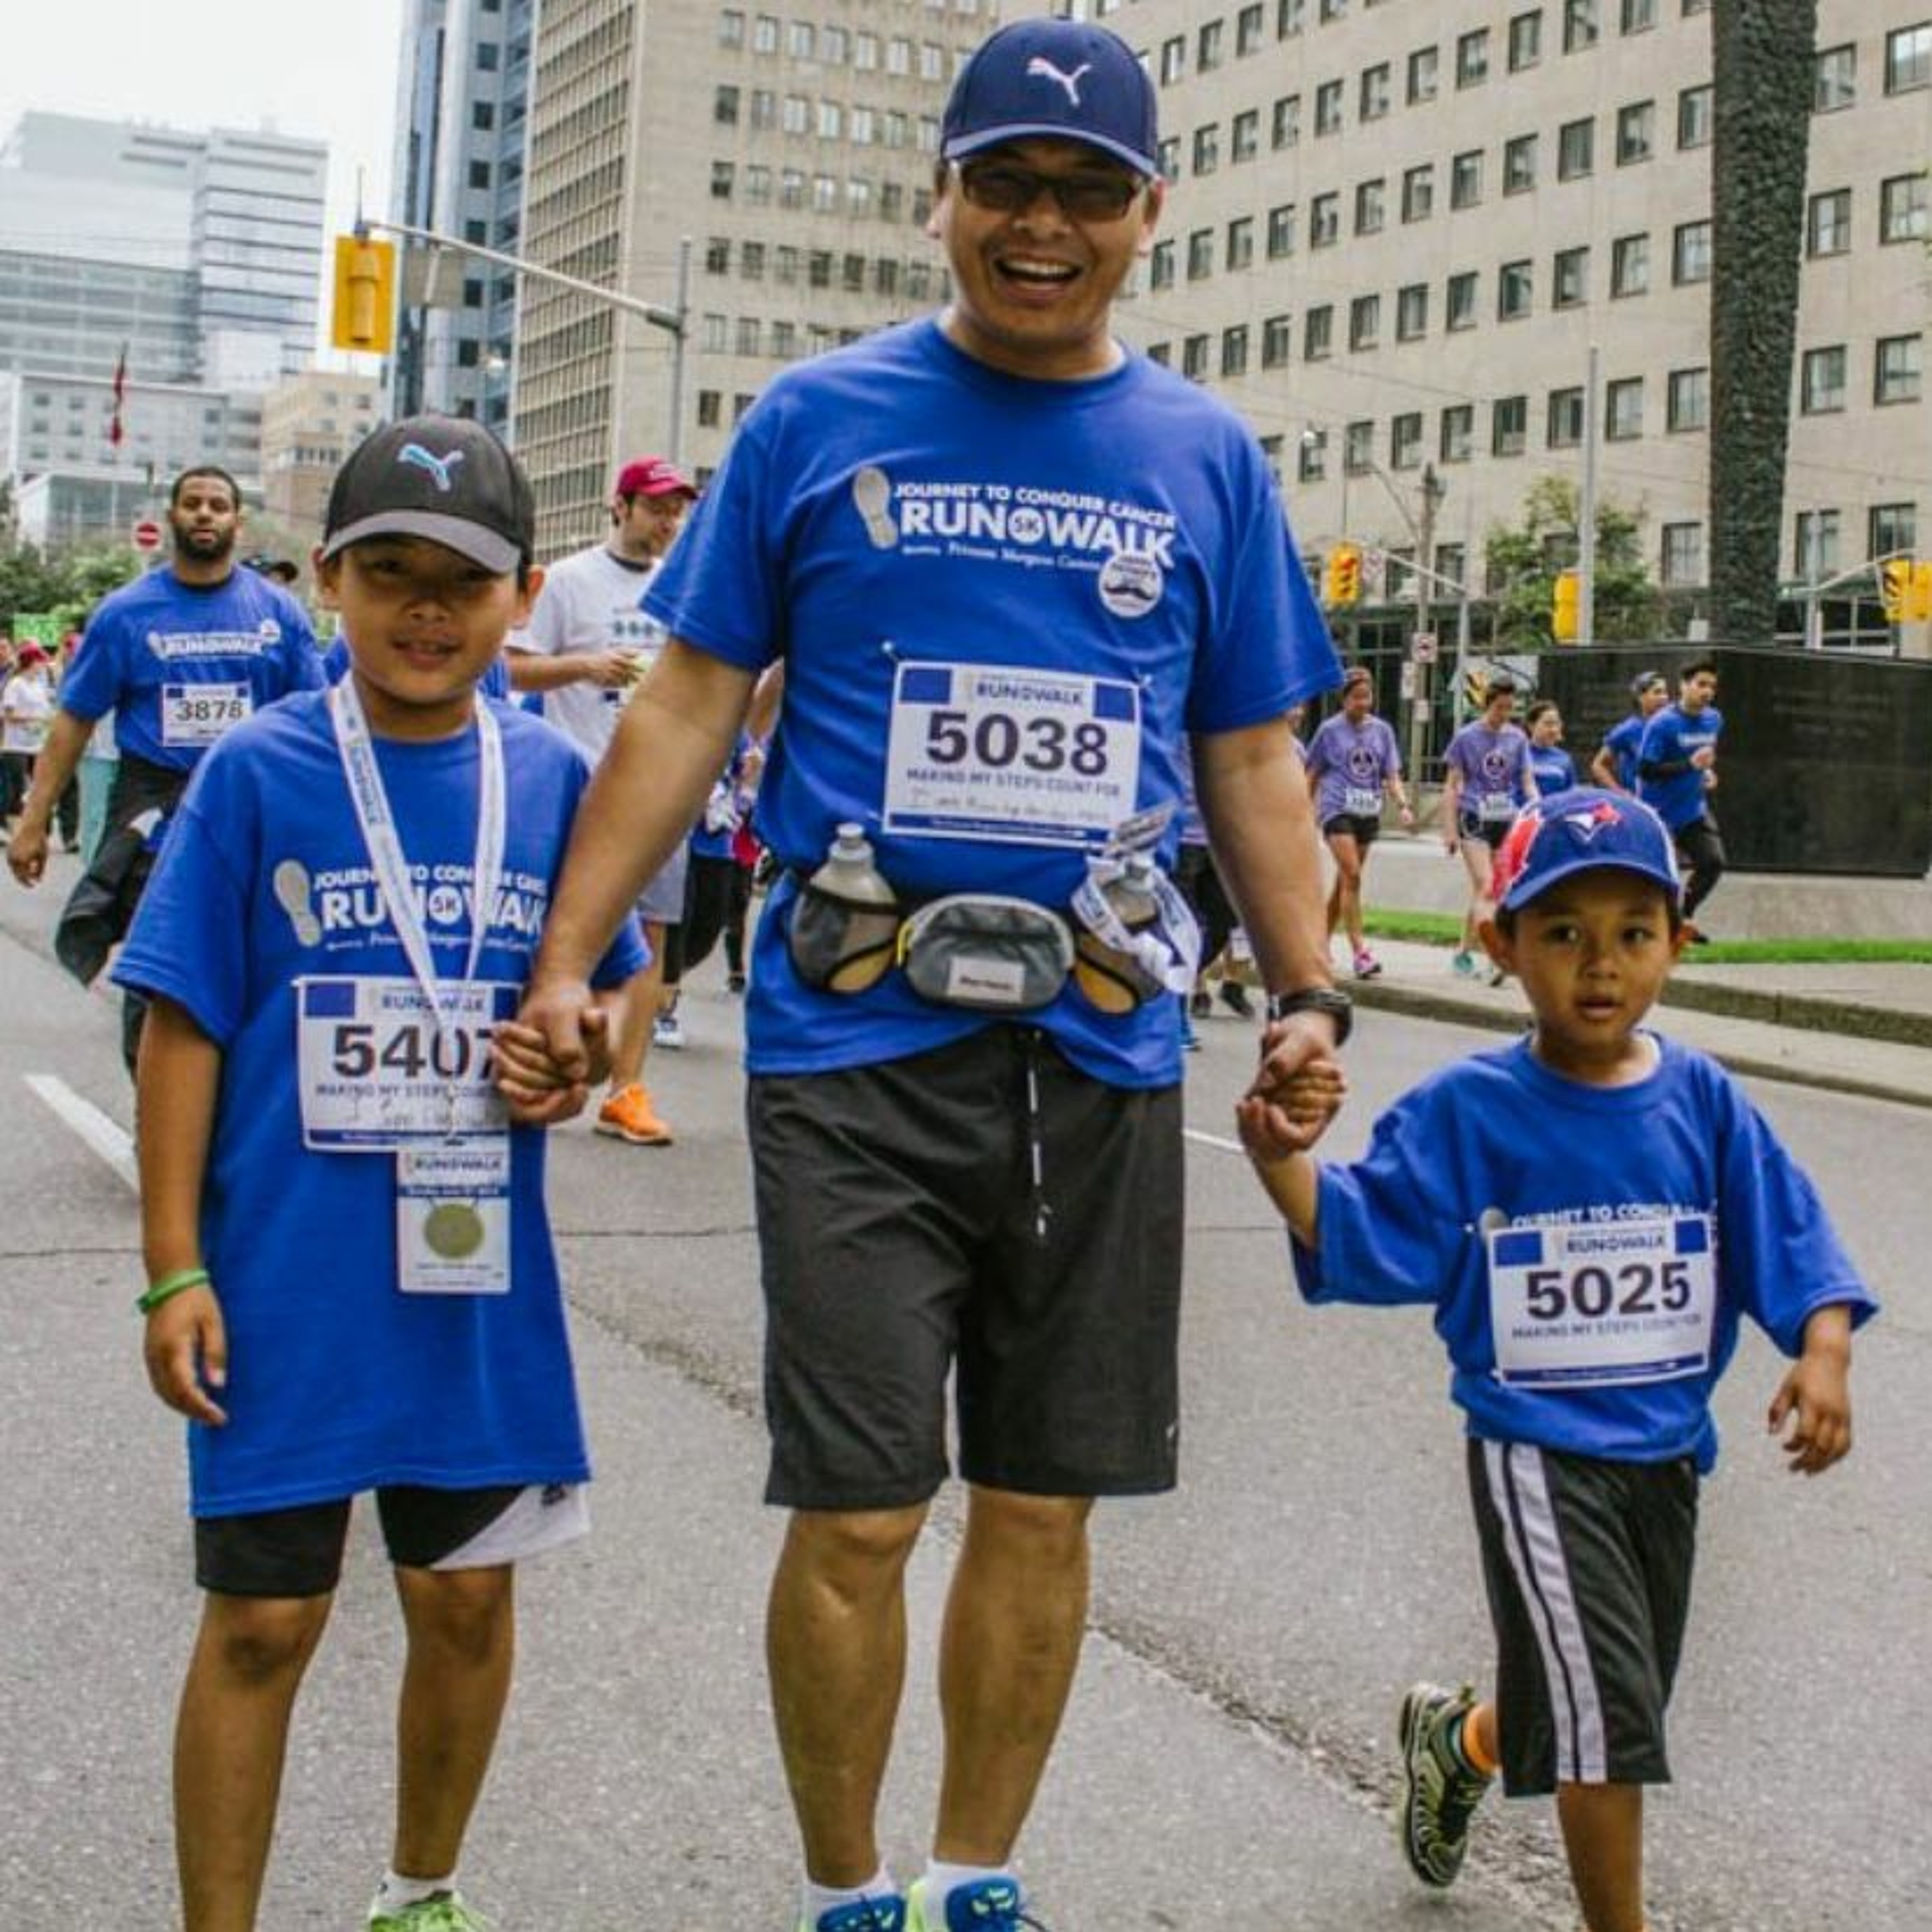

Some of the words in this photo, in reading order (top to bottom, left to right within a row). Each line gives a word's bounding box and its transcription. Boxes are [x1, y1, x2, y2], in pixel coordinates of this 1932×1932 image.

[894, 484, 979, 498] JOURNEY
[986, 486, 1009, 501] TO
[1016, 488, 1104, 515] CONQUER
[1108, 502, 1177, 529] CANCER
[926, 711, 1108, 777] 5038
[333, 1025, 495, 1080] 5407
[1586, 1205, 1613, 1222] TO
[1526, 1262, 1690, 1320] 5025
